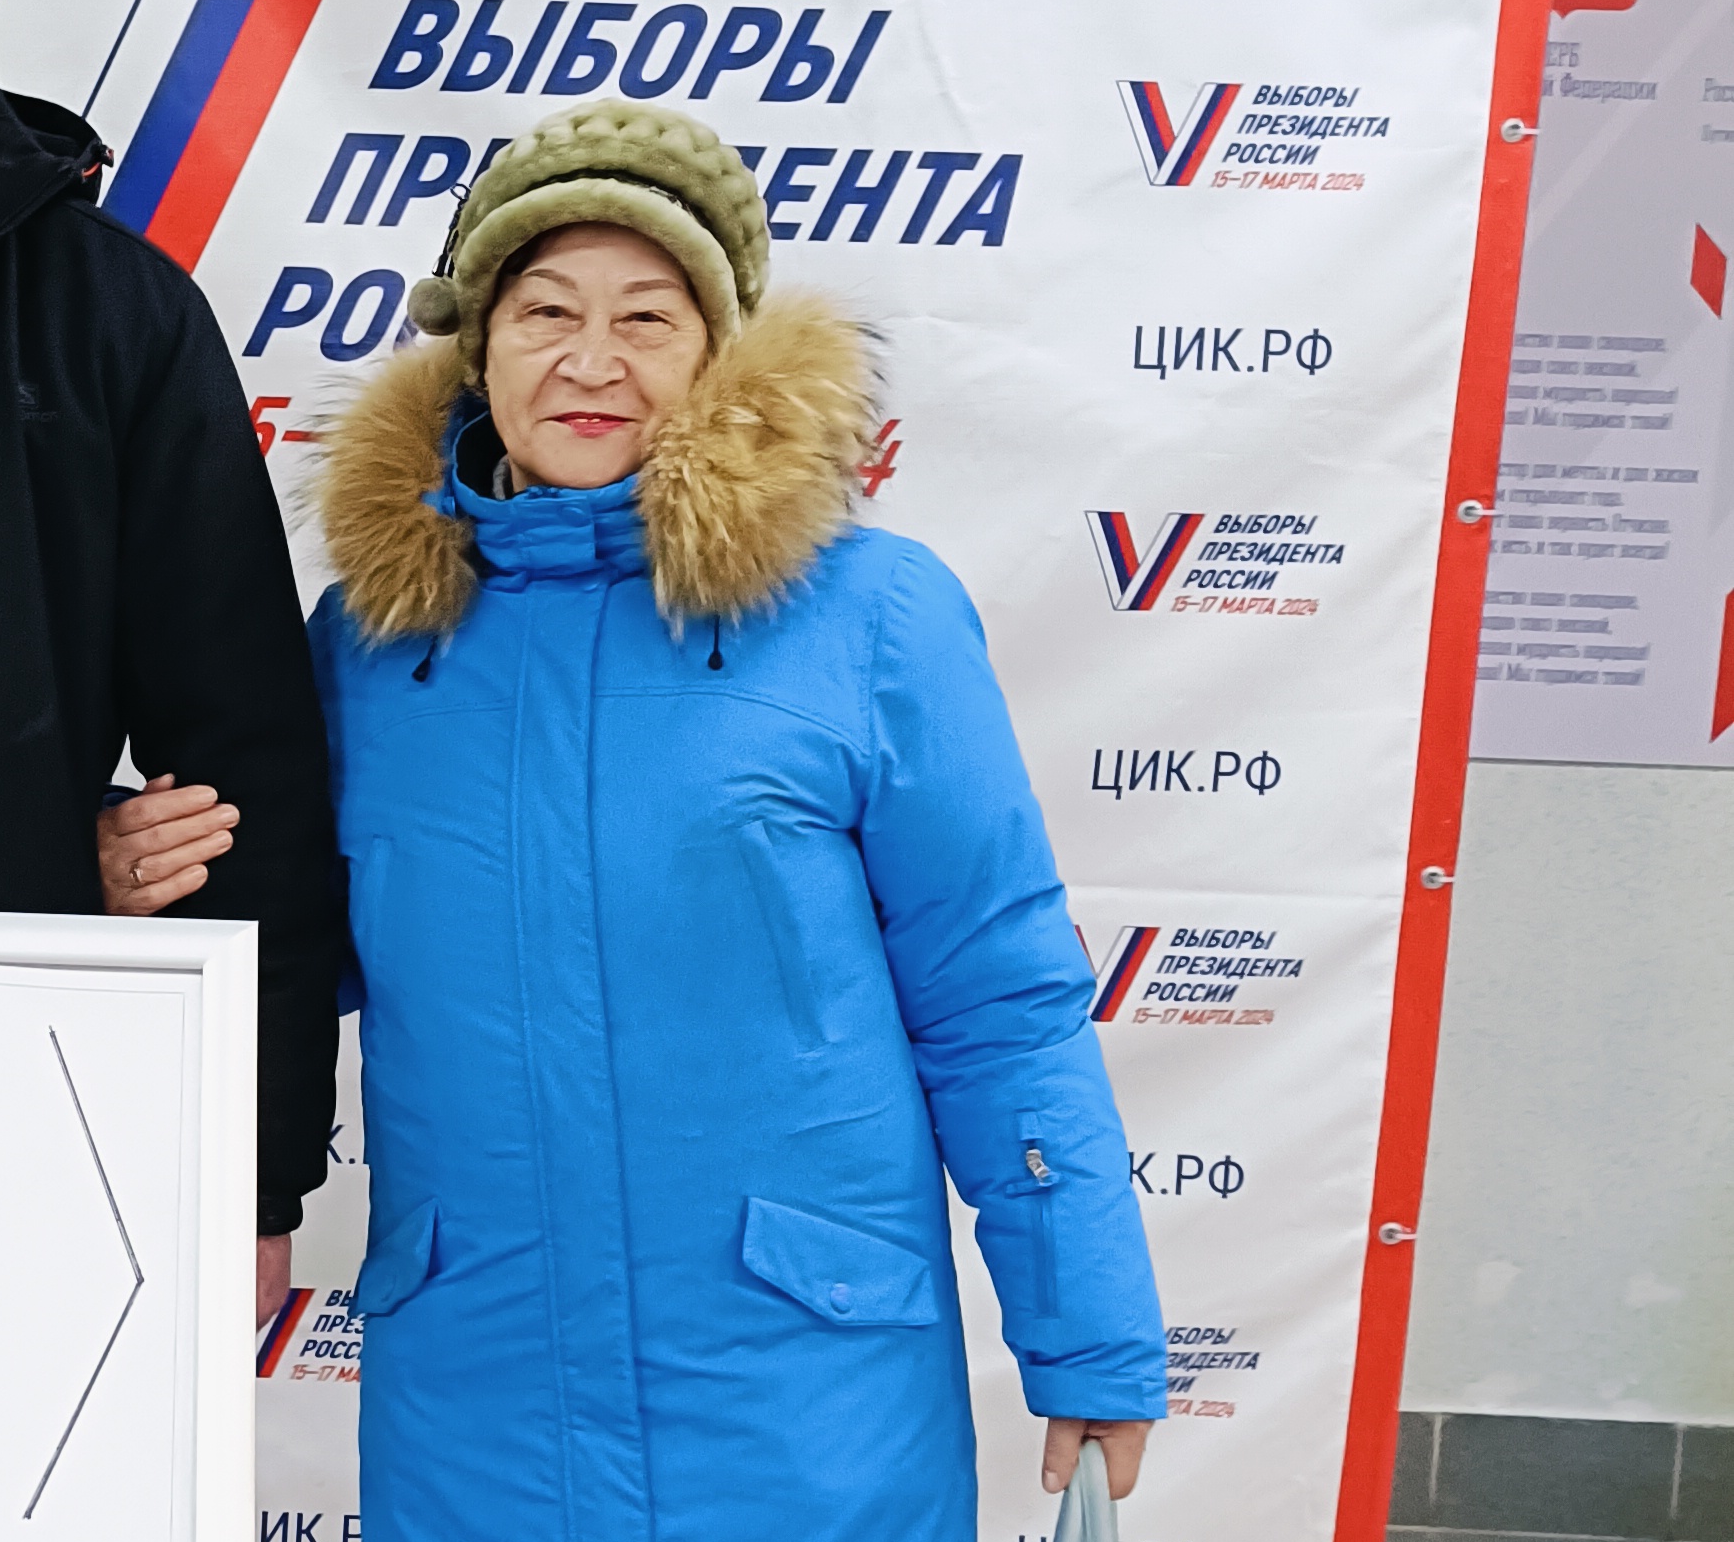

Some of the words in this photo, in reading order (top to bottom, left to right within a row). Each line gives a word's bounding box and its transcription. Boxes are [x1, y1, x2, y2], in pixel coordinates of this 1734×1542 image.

[1252, 85, 1360, 109] ВЫБОРЫ
[1237, 114, 1390, 141] ПРЕЗИДЕНТА
[1222, 142, 1319, 165] РОССИИ
[304, 132, 1023, 247] ПРЕНТА
[1261, 171, 1318, 192] МАРТА
[1321, 172, 1366, 192] 2024
[1132, 325, 1332, 380] ЦИК.РФ
[1213, 514, 1319, 535] ВЫБОРЫ
[1197, 541, 1346, 566] ПРЕЗИДЕНТА
[1182, 568, 1278, 590] РОССИИ
[1214, 597, 1277, 615] МАРТА
[1277, 598, 1320, 616] 2024
[1091, 748, 1282, 800] ЦИК.РФ
[1170, 928, 1277, 949] ВЫБОРЫ
[1156, 955, 1305, 979] ПРЕЗИДЕНТА
[1143, 982, 1239, 1002] РОССИИ
[1178, 1009, 1235, 1025] МАРТА
[1127, 1151, 1244, 1199] К.РФ
[299, 1339, 361, 1359] РОСС
[1165, 1352, 1260, 1372] ЗИДЕНТА
